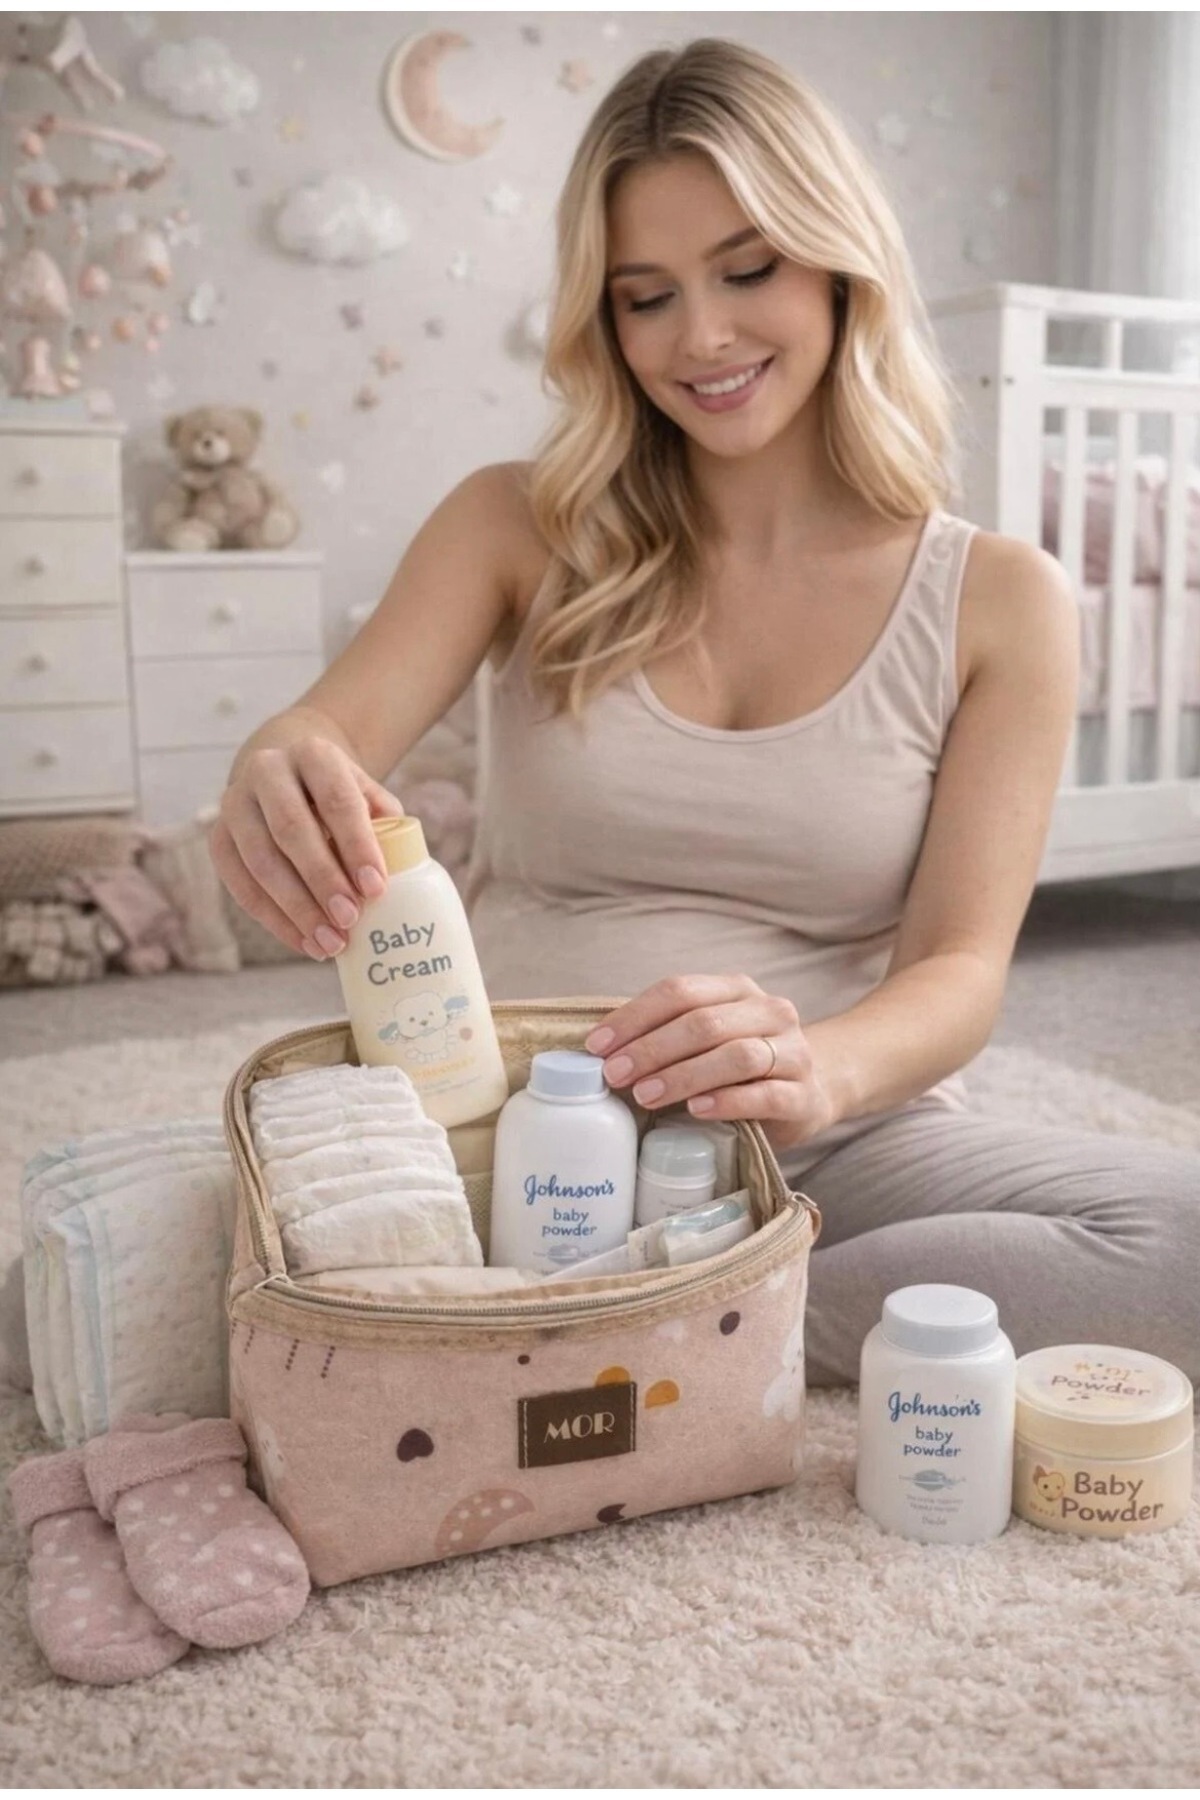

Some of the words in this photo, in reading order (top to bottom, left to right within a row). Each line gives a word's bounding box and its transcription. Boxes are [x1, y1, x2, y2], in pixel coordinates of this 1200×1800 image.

[369, 922, 435, 954] Baby
[367, 953, 452, 985] Cream
[524, 1174, 615, 1206] Johnson's
[542, 1223, 597, 1238] powder
[553, 1208, 590, 1228] baby
[888, 1391, 981, 1423] Johnson's
[544, 1411, 616, 1443] MOR
[915, 1425, 954, 1444] baby
[903, 1443, 962, 1458] powder
[1074, 1471, 1144, 1501] Baby
[1061, 1497, 1164, 1522] Powder
